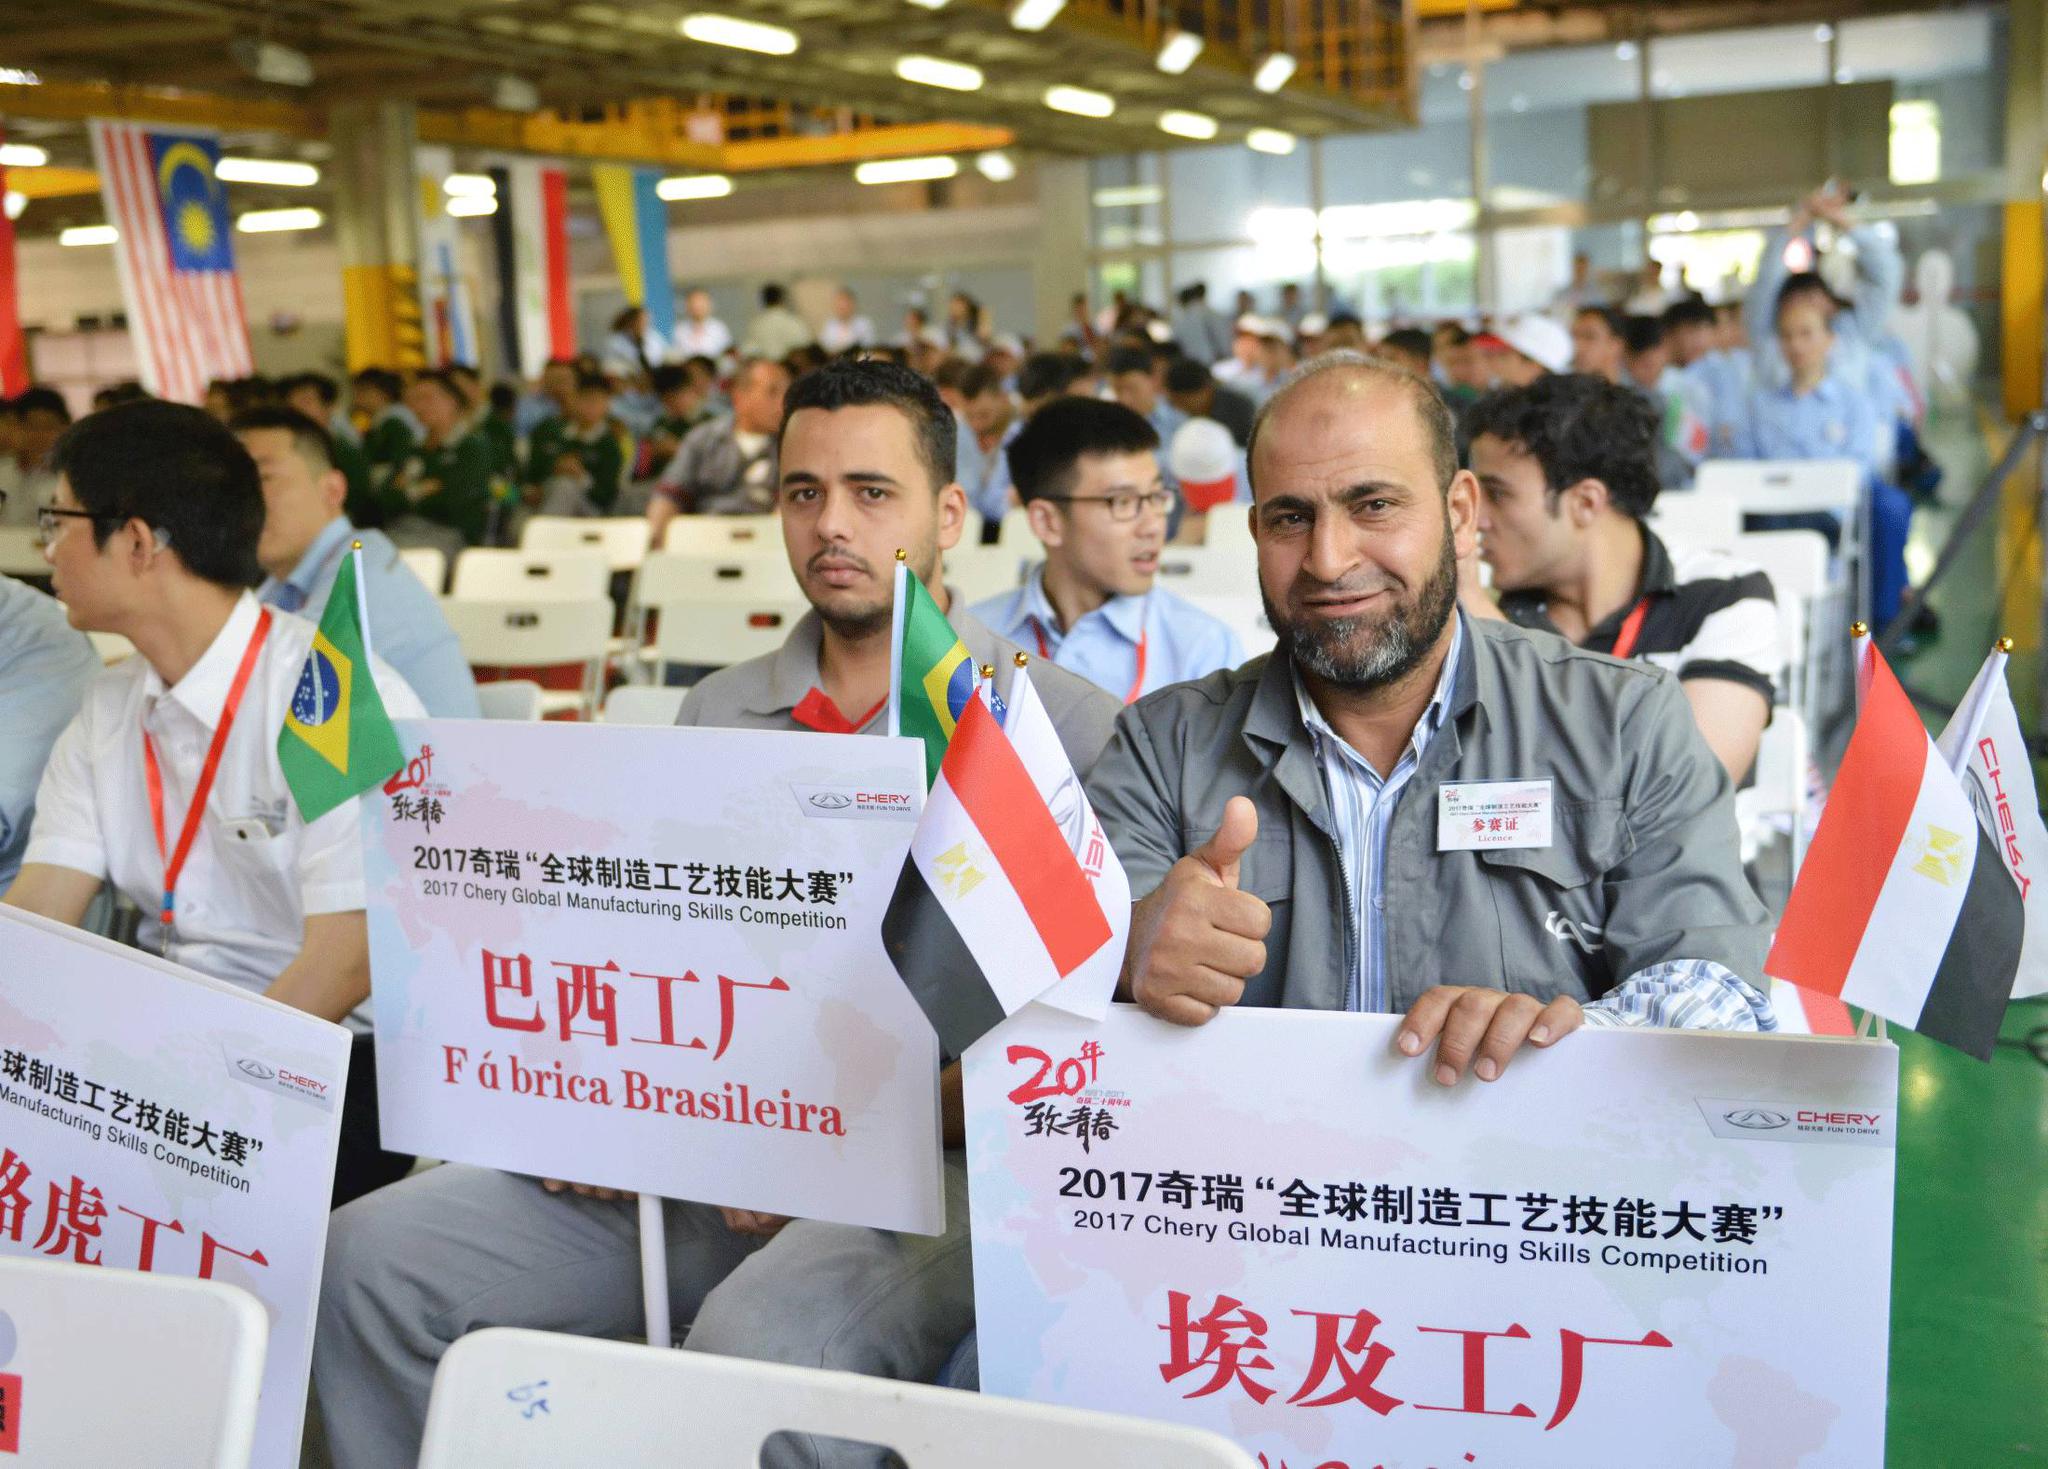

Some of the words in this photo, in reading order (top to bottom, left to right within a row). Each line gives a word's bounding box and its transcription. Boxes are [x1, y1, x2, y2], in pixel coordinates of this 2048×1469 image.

[856, 793, 911, 805] CHERY
[1472, 817, 1519, 832] 参赛证
[1978, 737, 2031, 901] CHERY
[1478, 834, 1513, 842] Licence
[423, 879, 459, 897] 2017
[463, 882, 507, 906] Chery
[512, 886, 561, 906] Global
[567, 892, 682, 922] Manufacturing
[687, 902, 734, 922] Skills
[740, 906, 847, 931] Competition
[481, 948, 790, 1061] 巴西工厂
[279, 1070, 327, 1092] CHERY
[621, 1070, 848, 1138] Brasileira
[0, 1085, 101, 1140] Manufacturing
[107, 1126, 149, 1155] Skills
[154, 1144, 250, 1193] Competition
[1023, 1102, 1119, 1155] 致青春
[1798, 1111, 1880, 1126] CHERY
[1073, 1210, 1135, 1231] 2017
[1144, 1215, 1219, 1244] Chery
[1228, 1220, 1310, 1246] Global
[1321, 1227, 1508, 1264] Manufacturing
[1518, 1240, 1591, 1264] Skills
[1601, 1245, 1768, 1275] Competition
[1158, 1290, 1673, 1430] 埃及工厂
